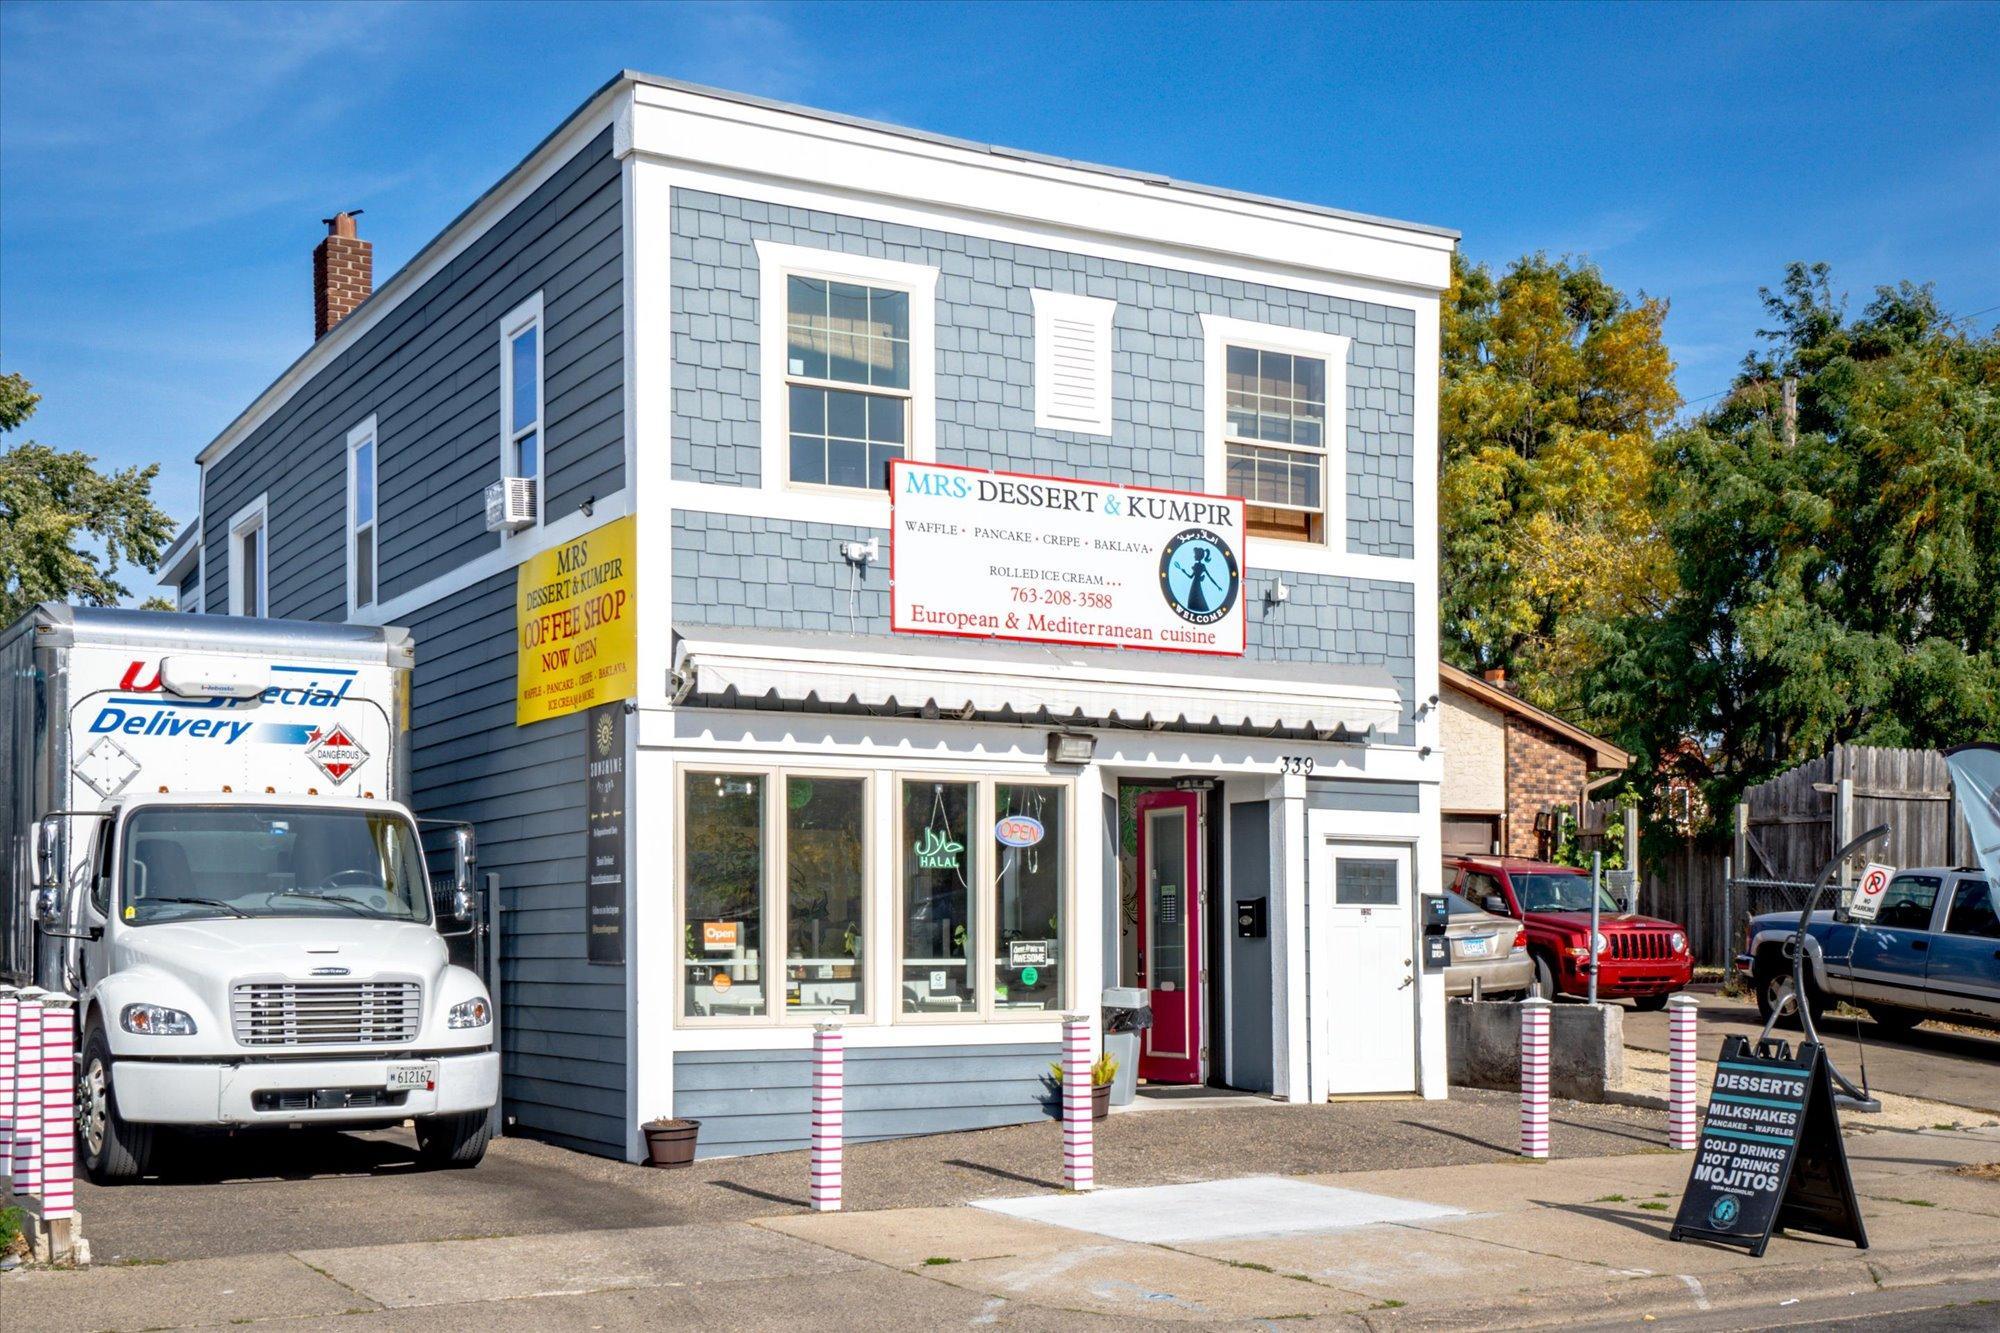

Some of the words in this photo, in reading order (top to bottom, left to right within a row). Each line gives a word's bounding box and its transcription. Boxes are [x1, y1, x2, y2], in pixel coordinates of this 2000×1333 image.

[977, 479, 1098, 513] DESSERT
[1104, 494, 1121, 516] &
[1127, 496, 1233, 527] KUMPIR
[905, 520, 958, 536] WAFFLE
[974, 527, 1032, 543] PANCAKE
[1043, 534, 1081, 548] CREPE
[557, 540, 588, 576] MRS
[526, 577, 571, 611] DESSERT
[572, 576, 579, 596] &
[580, 558, 623, 593] KUMPIR
[989, 565, 1039, 580] ROLLED
[1041, 569, 1060, 582] ICE
[1010, 586, 1112, 609] 763-208-3588
[524, 605, 581, 650] COFFEE
[584, 588, 626, 632] SHOP
[911, 604, 999, 631] European
[1005, 612, 1020, 630] &
[1028, 614, 1153, 641] Mediterranean
[1160, 627, 1216, 645] cuisine
[1175, 604, 1223, 623] WELCOME
[542, 648, 571, 673] NOW
[574, 637, 598, 666] OPEN
[88, 708, 253, 744] Delivery
[317, 749, 359, 760] DANGEROUS
[1280, 756, 1314, 775] 339
[1001, 821, 1038, 841] OPEN
[920, 857, 959, 867] HALAL
[1854, 904, 1875, 913] PARKING
[706, 927, 734, 940] Open
[1716, 1073, 1805, 1097] DESSERTS
[1709, 1103, 1797, 1125] MILKSHAKES
[1707, 1119, 1748, 1131] PANCAKES
[1755, 1125, 1794, 1137] WAFFELES
[1704, 1138, 1738, 1153] COLD
[1739, 1144, 1786, 1161] DRINKS
[1702, 1153, 1730, 1167] HOT
[1732, 1157, 1780, 1173] DRINKS
[1694, 1164, 1780, 1192] MOJITOS
